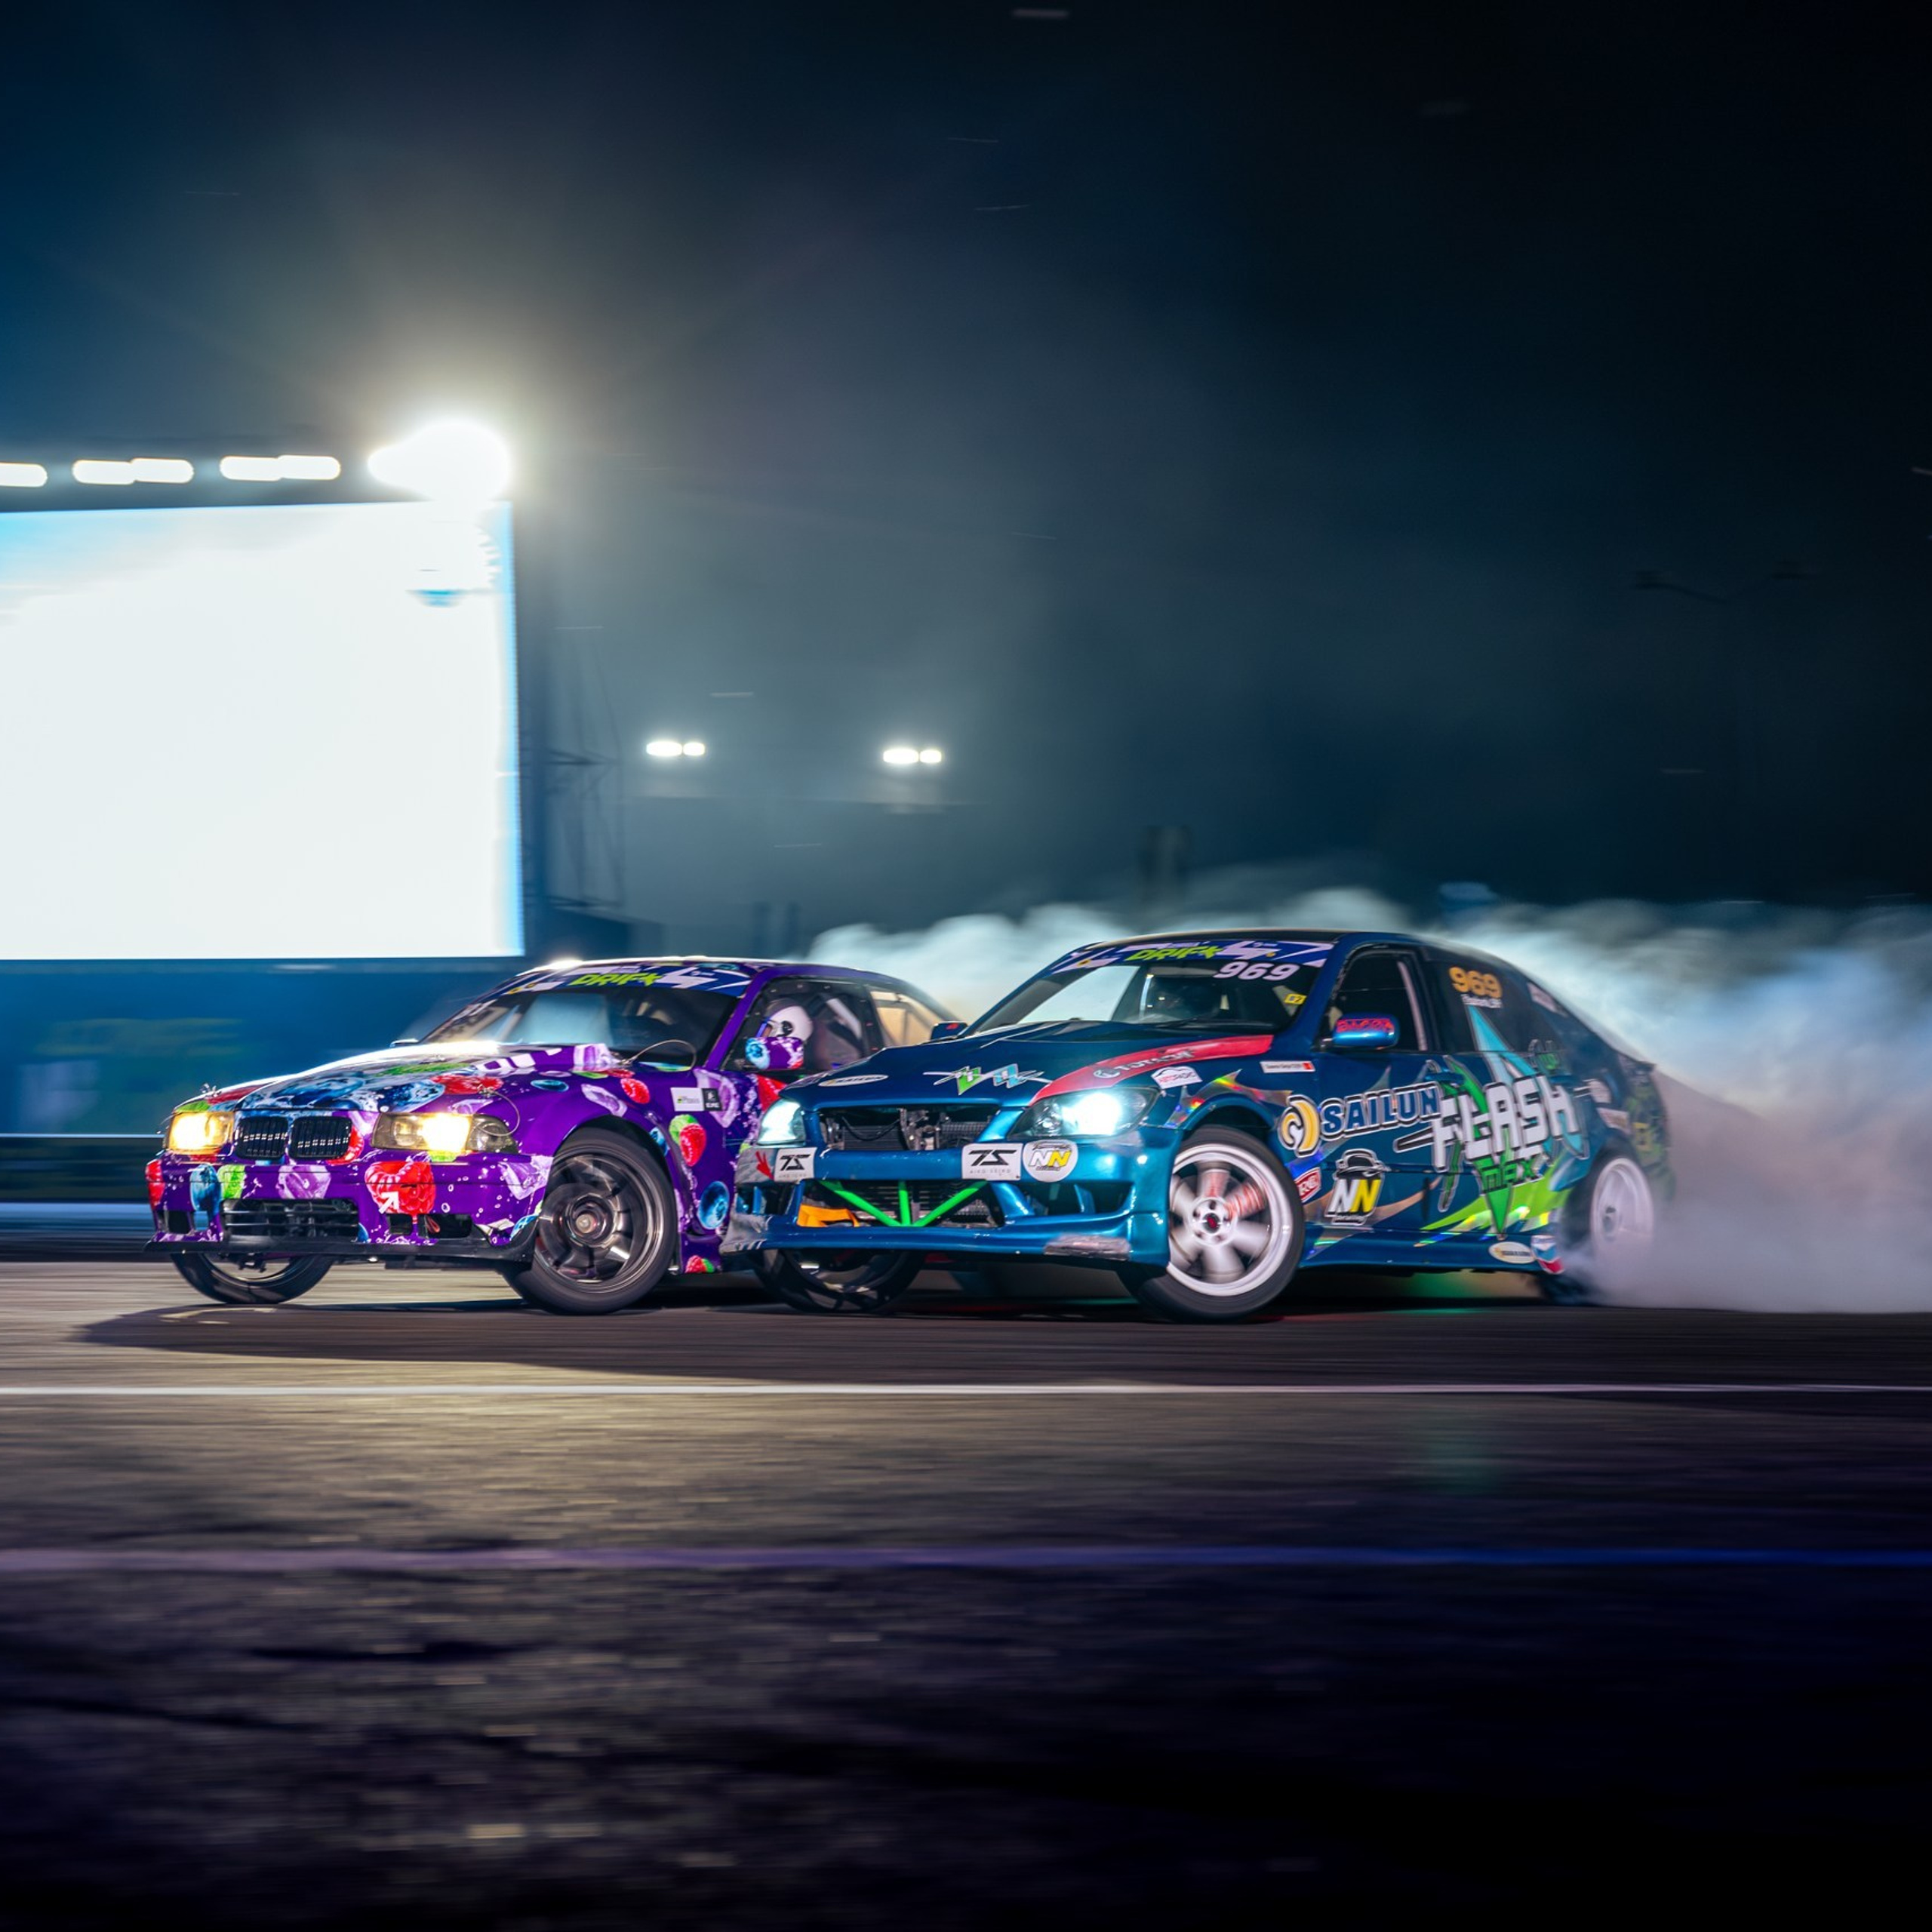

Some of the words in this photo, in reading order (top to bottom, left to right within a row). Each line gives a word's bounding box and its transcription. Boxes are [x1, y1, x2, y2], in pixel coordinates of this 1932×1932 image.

[1213, 961, 1300, 981] 969
[1448, 967, 1503, 998] 969
[1321, 1086, 1440, 1136] SAILUN
[1028, 1149, 1072, 1168] NN
[1327, 1178, 1382, 1213] NN
